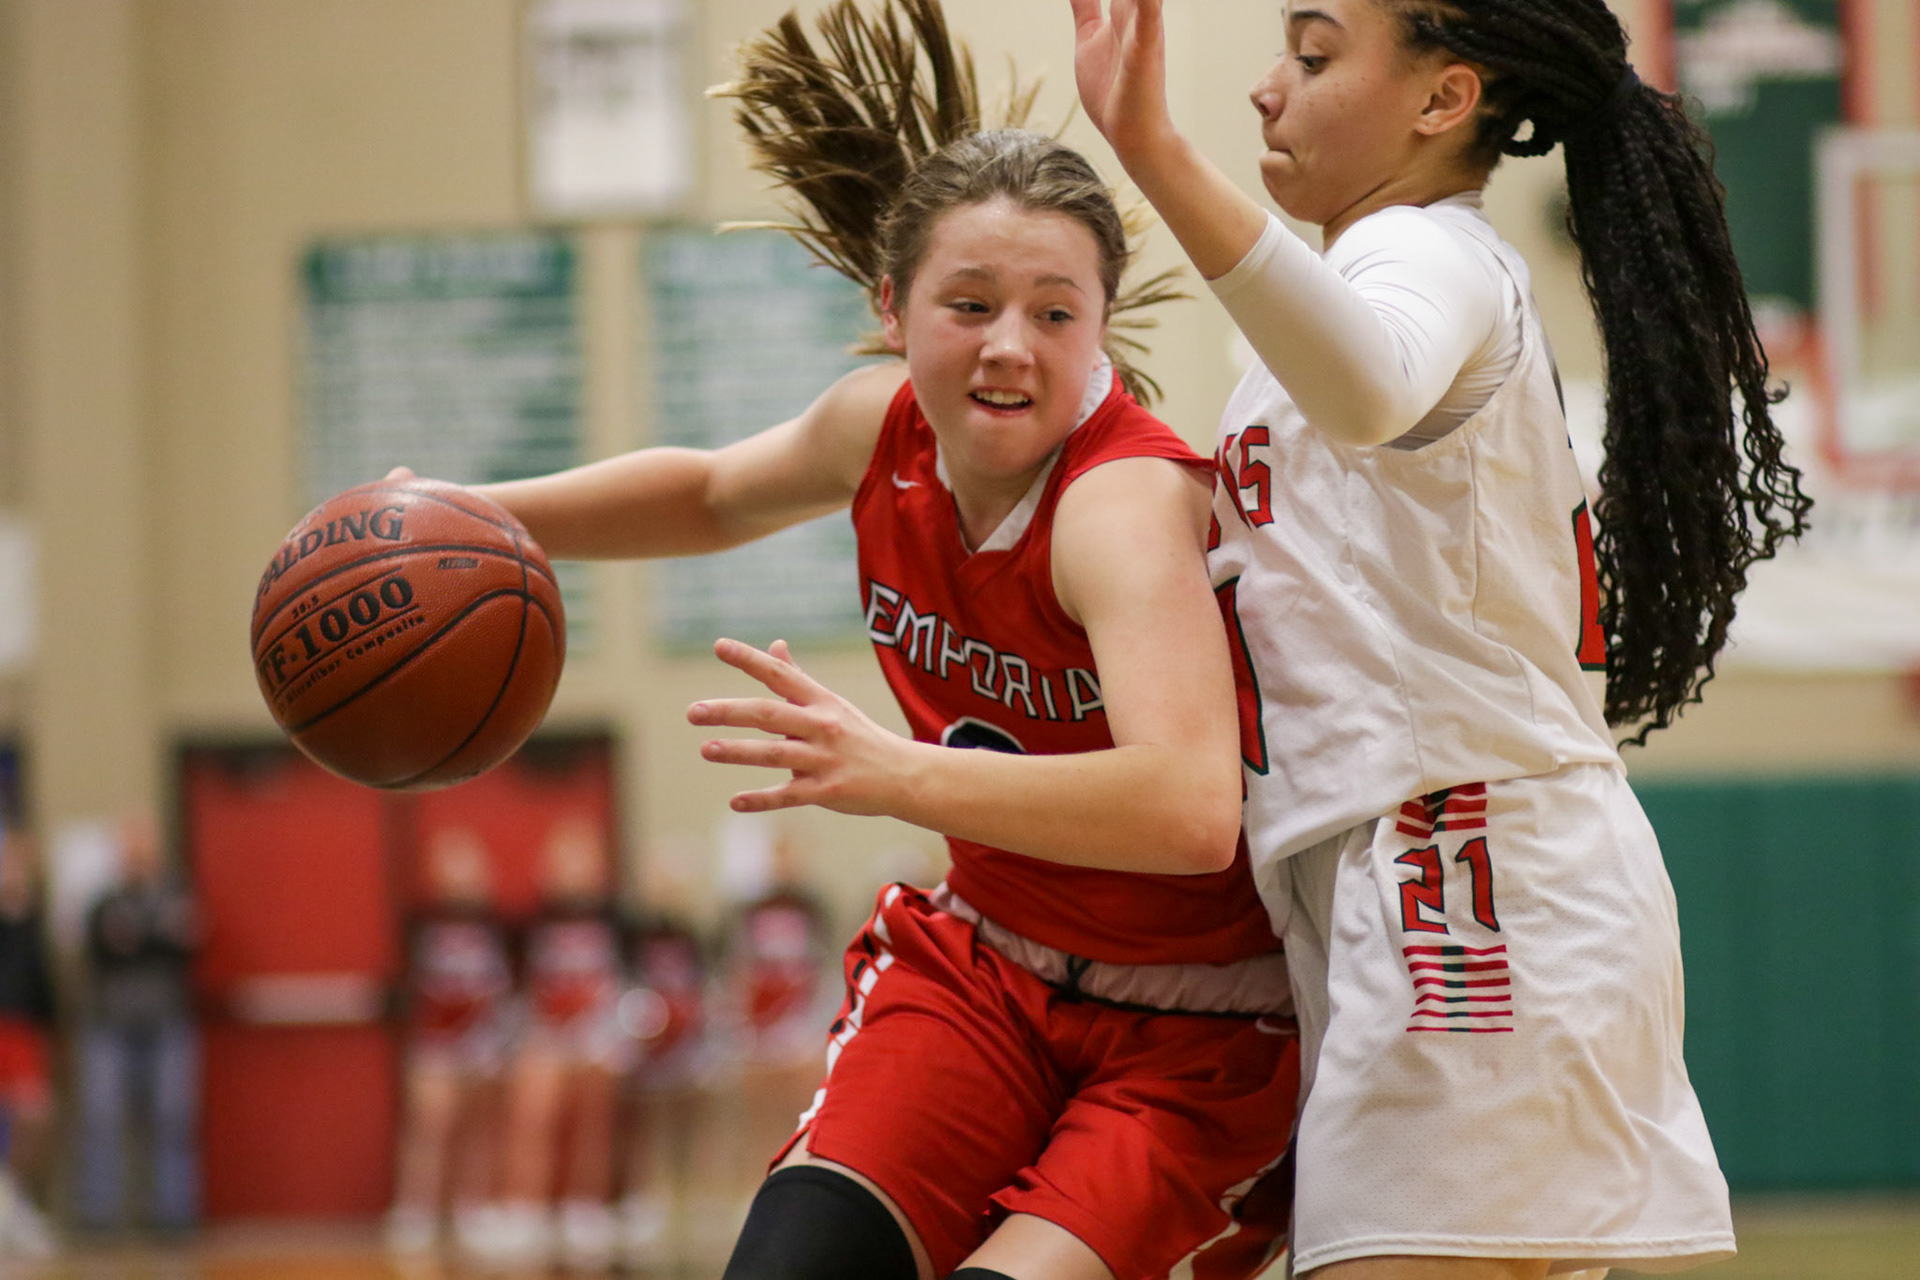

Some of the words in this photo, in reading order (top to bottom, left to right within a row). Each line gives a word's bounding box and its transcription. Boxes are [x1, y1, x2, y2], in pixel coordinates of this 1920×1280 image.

[346, 614, 426, 661] Composite
[865, 576, 1106, 723] EMPORIA
[1393, 835, 1501, 936] 21
